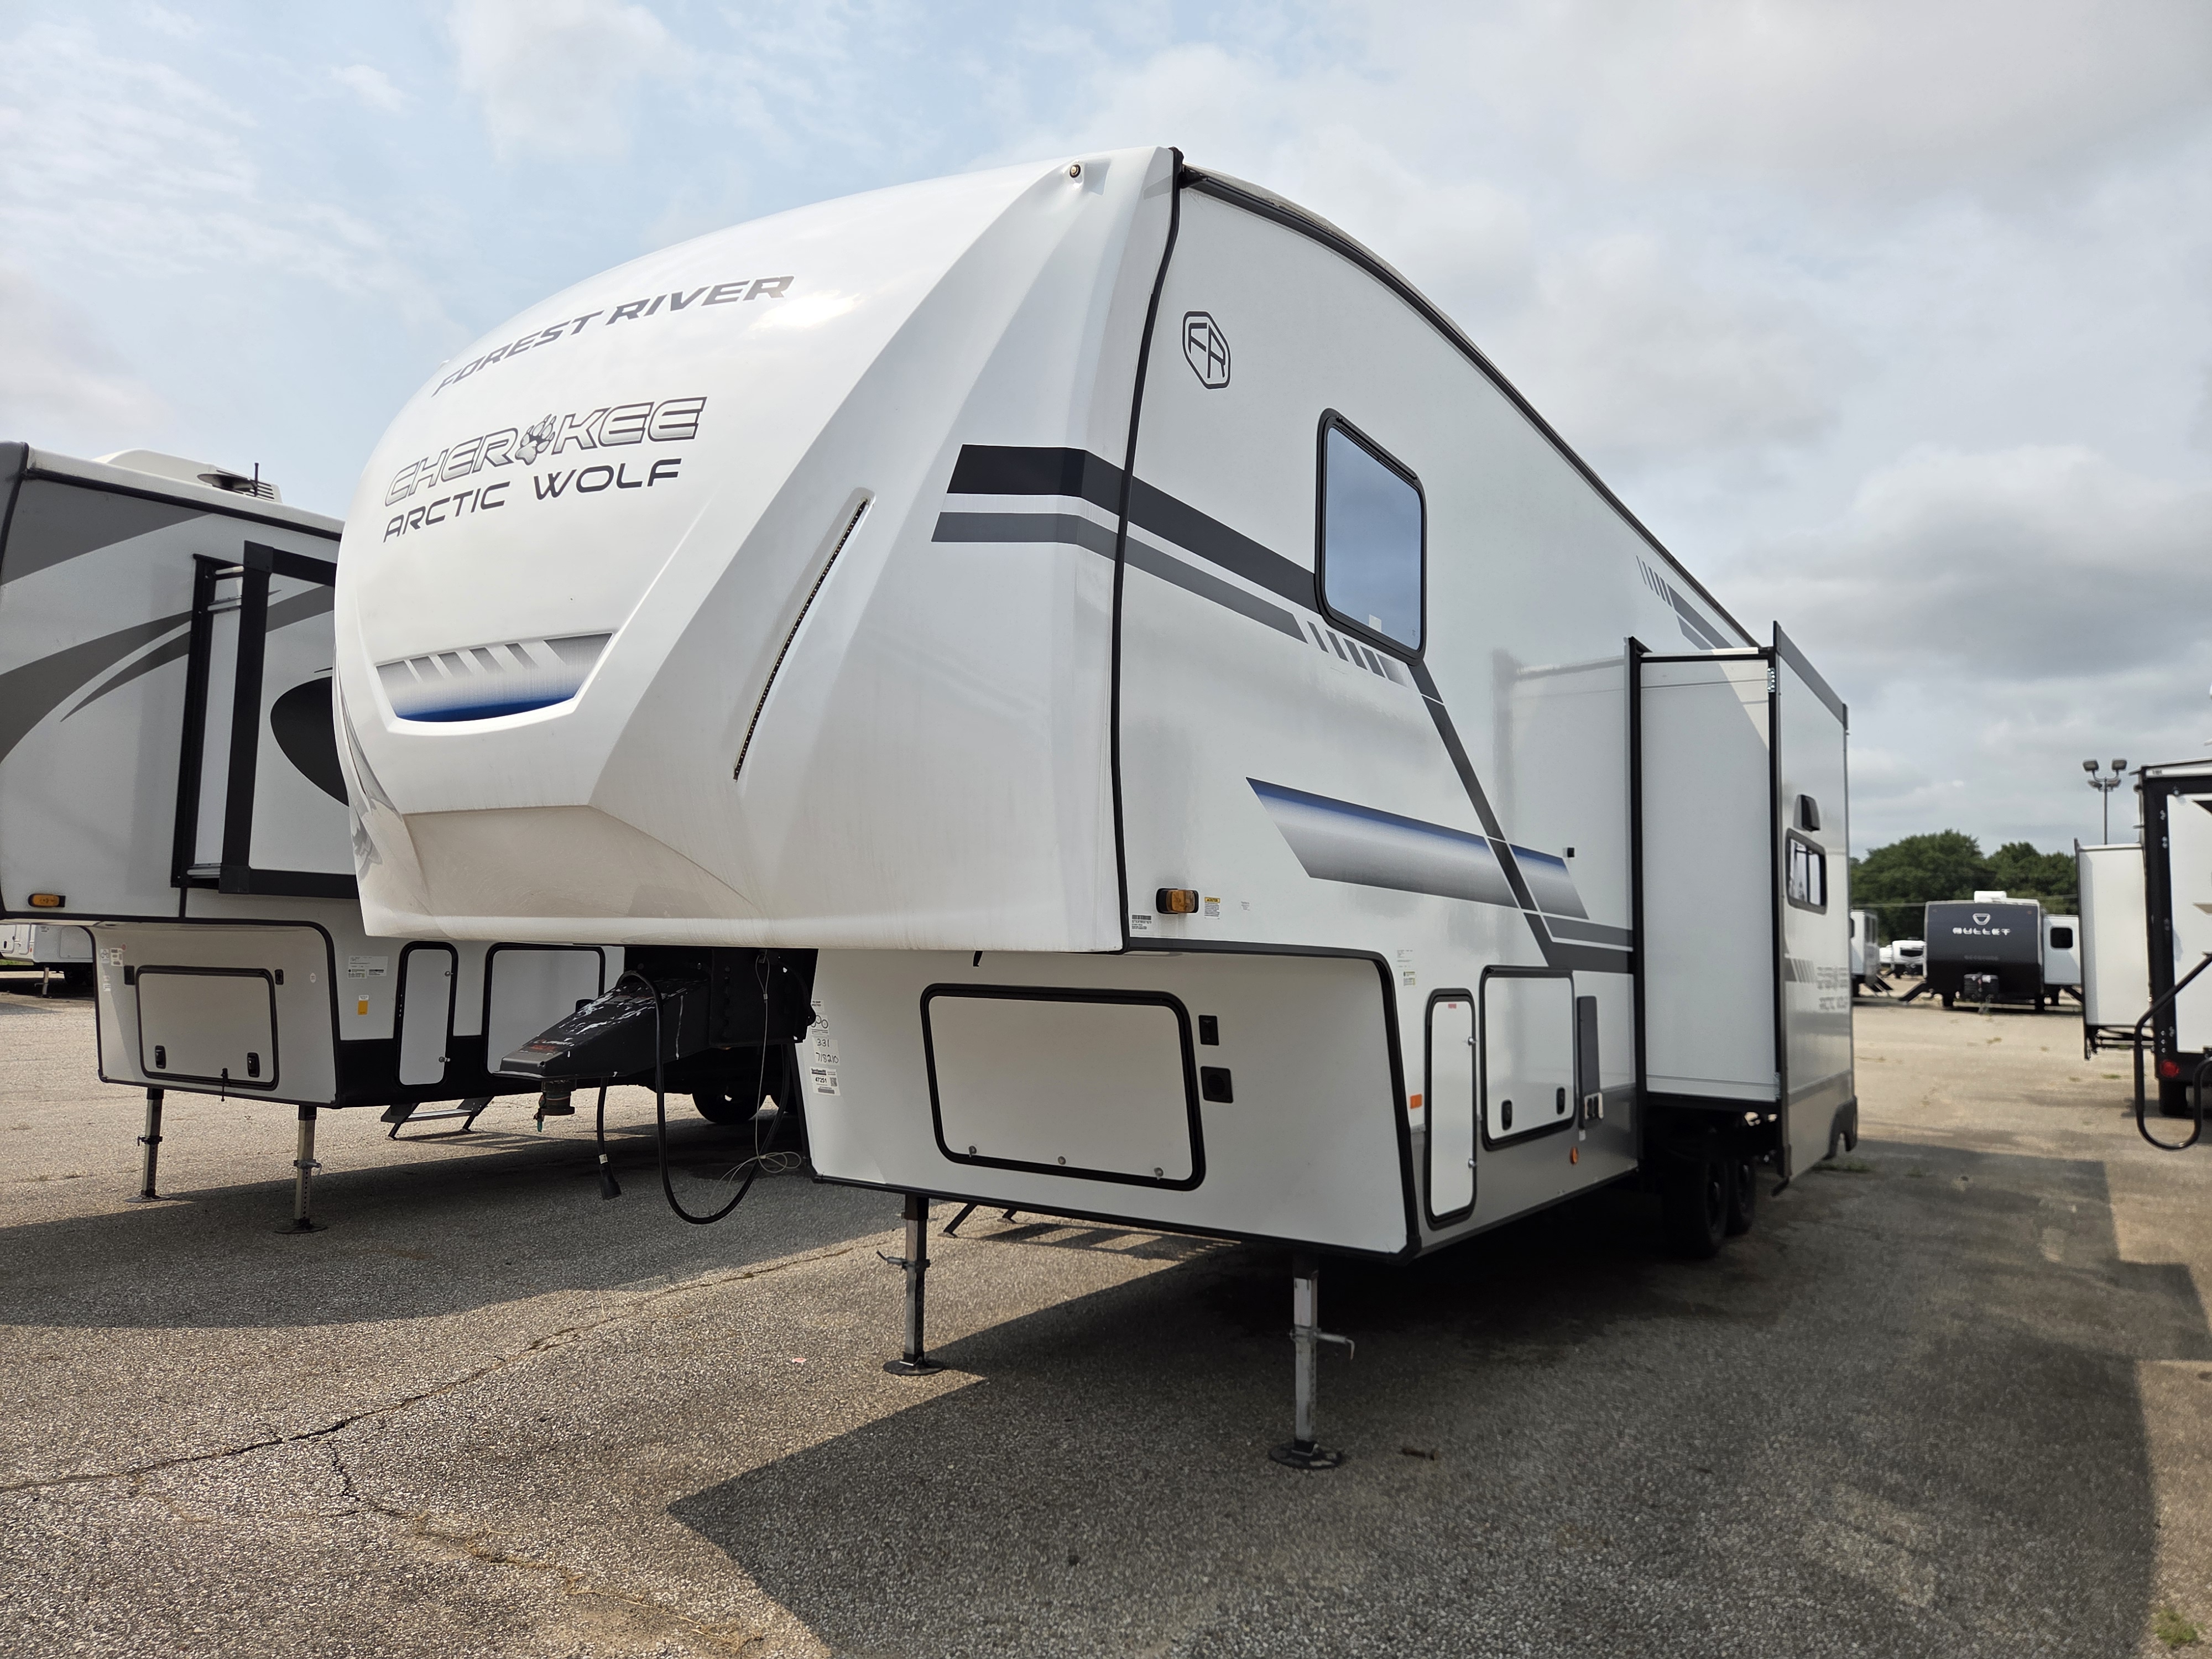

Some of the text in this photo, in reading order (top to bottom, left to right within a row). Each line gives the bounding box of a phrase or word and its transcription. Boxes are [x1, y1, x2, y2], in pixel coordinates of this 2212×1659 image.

[431, 275, 794, 398] FOREST RIVER
[383, 458, 682, 543] ARCTIC WOLF
[1952, 927, 2011, 936] BULLET
[817, 1039, 830, 1047] 331
